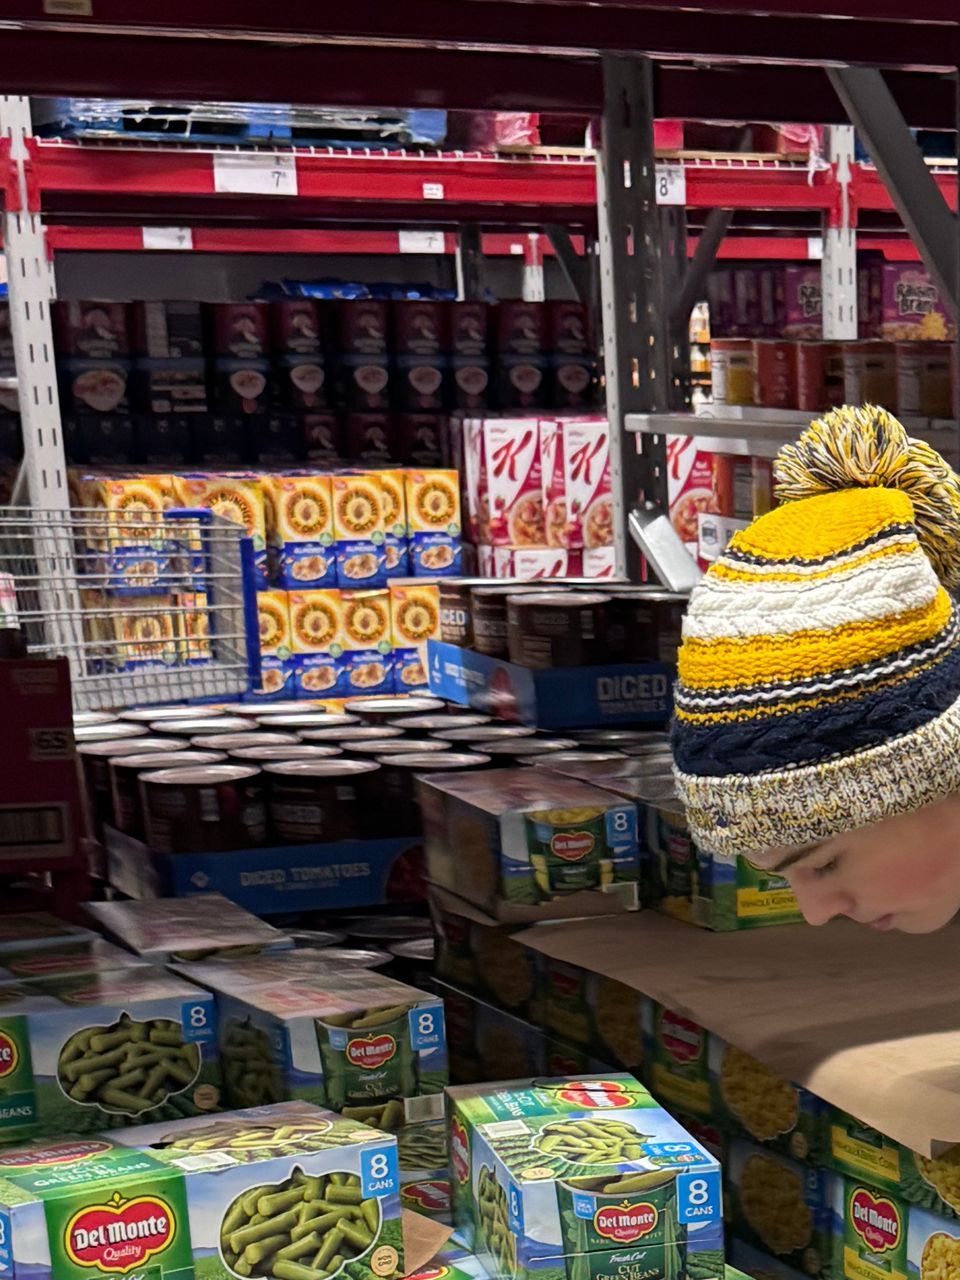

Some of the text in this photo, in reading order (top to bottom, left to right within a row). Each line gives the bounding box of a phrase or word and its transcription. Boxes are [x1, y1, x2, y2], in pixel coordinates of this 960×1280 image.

[597, 674, 667, 700] DICED
[613, 812, 628, 832] 8
[190, 1006, 208, 1027] 8
[418, 1012, 435, 1035] 8
[369, 1154, 389, 1178] 8
[368, 1179, 394, 1192] CANS
[687, 1179, 710, 1205] 8
[684, 1206, 714, 1218] CANS
[73, 1213, 168, 1251] Del Monte
[103, 1244, 142, 1262] Quality
